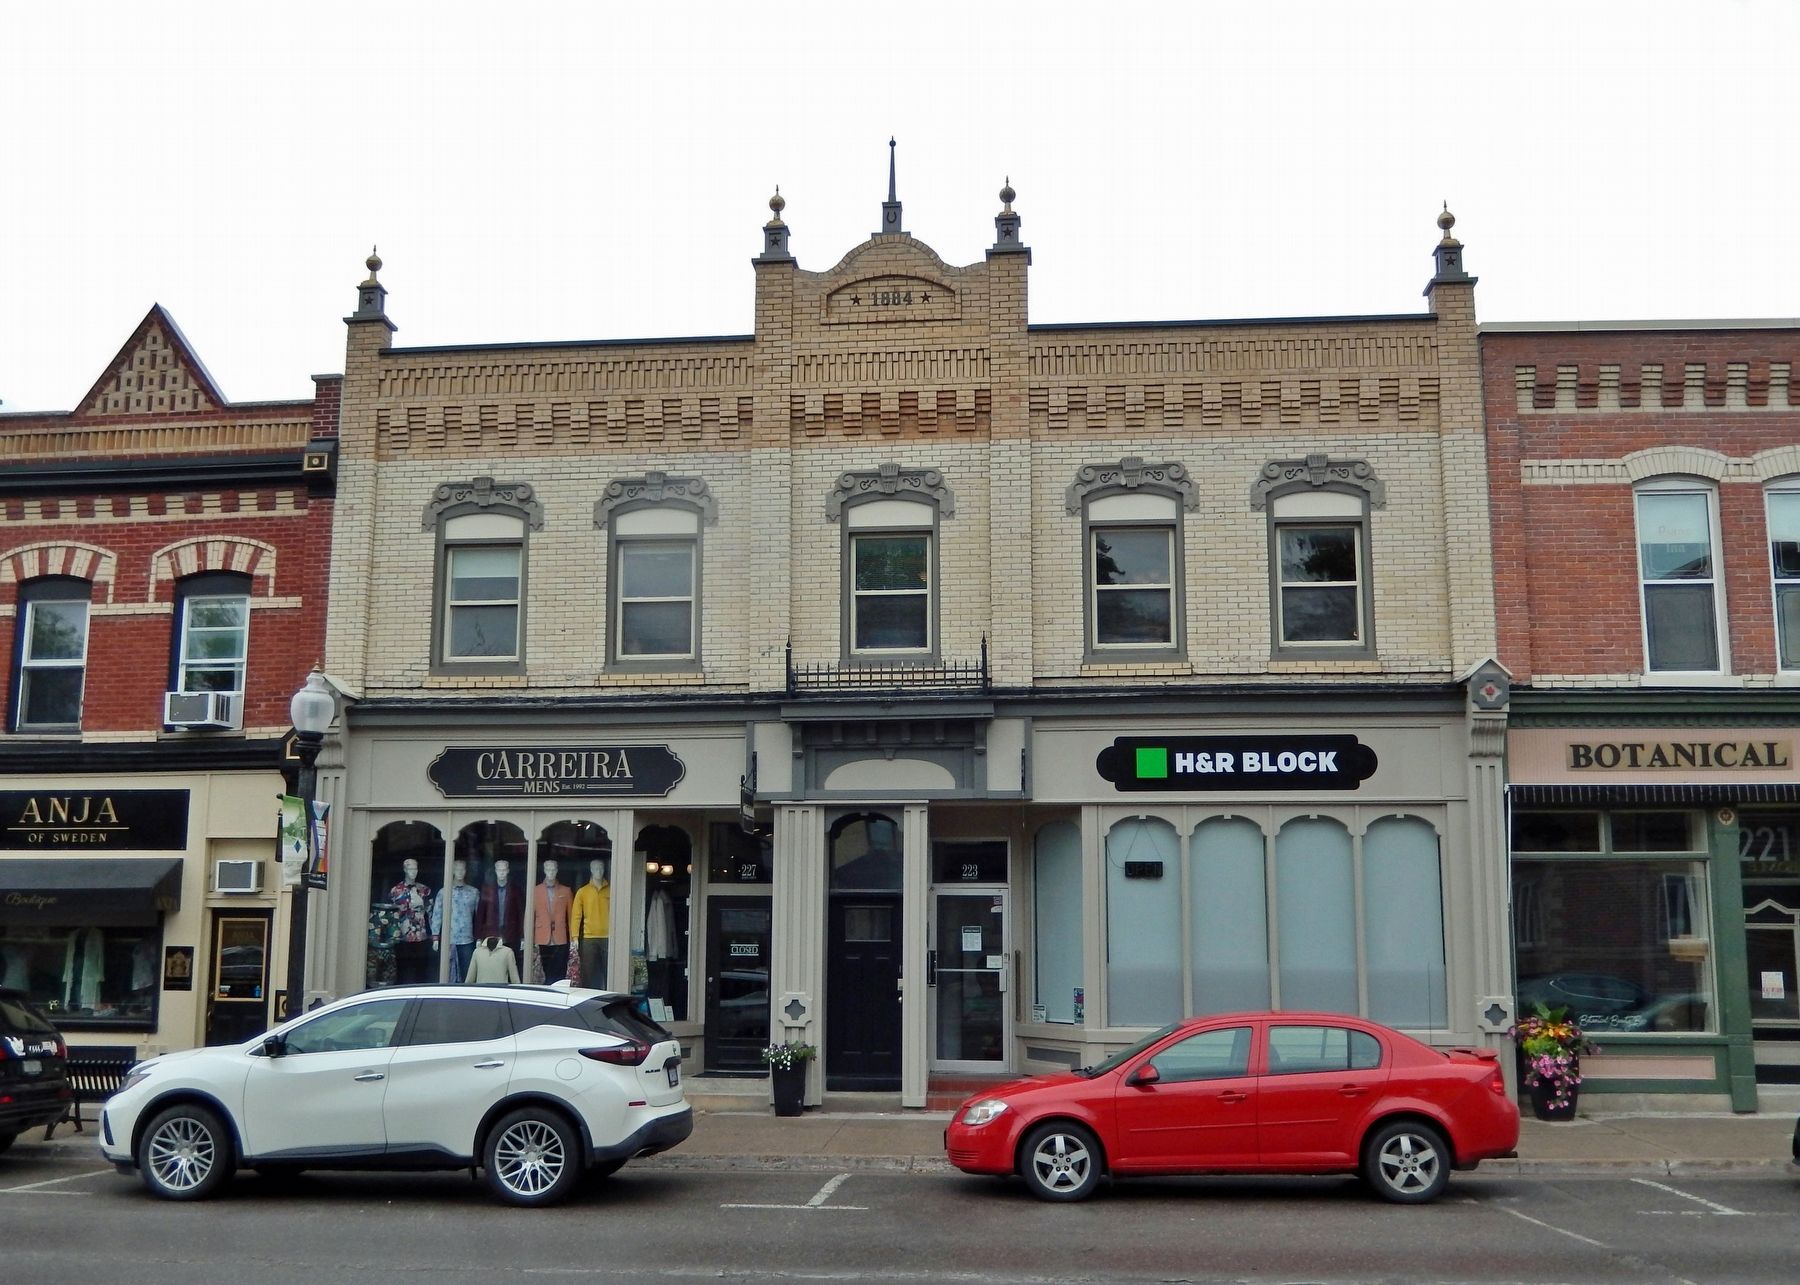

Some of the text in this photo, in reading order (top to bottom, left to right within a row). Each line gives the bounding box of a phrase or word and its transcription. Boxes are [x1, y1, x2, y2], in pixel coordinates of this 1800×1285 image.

[871, 291, 912, 305] 1884
[1175, 751, 1338, 773] H&R BLOCK
[1569, 742, 1788, 768] BOTANICAL
[476, 749, 634, 780] CARREIRA
[523, 780, 560, 793] MENS
[19, 797, 120, 824] ANJA
[28, 832, 108, 843] OF SWEDEN
[1739, 826, 1791, 862] 221
[741, 864, 757, 876] 227
[962, 864, 978, 877] 223
[731, 946, 758, 954] CLOSED
